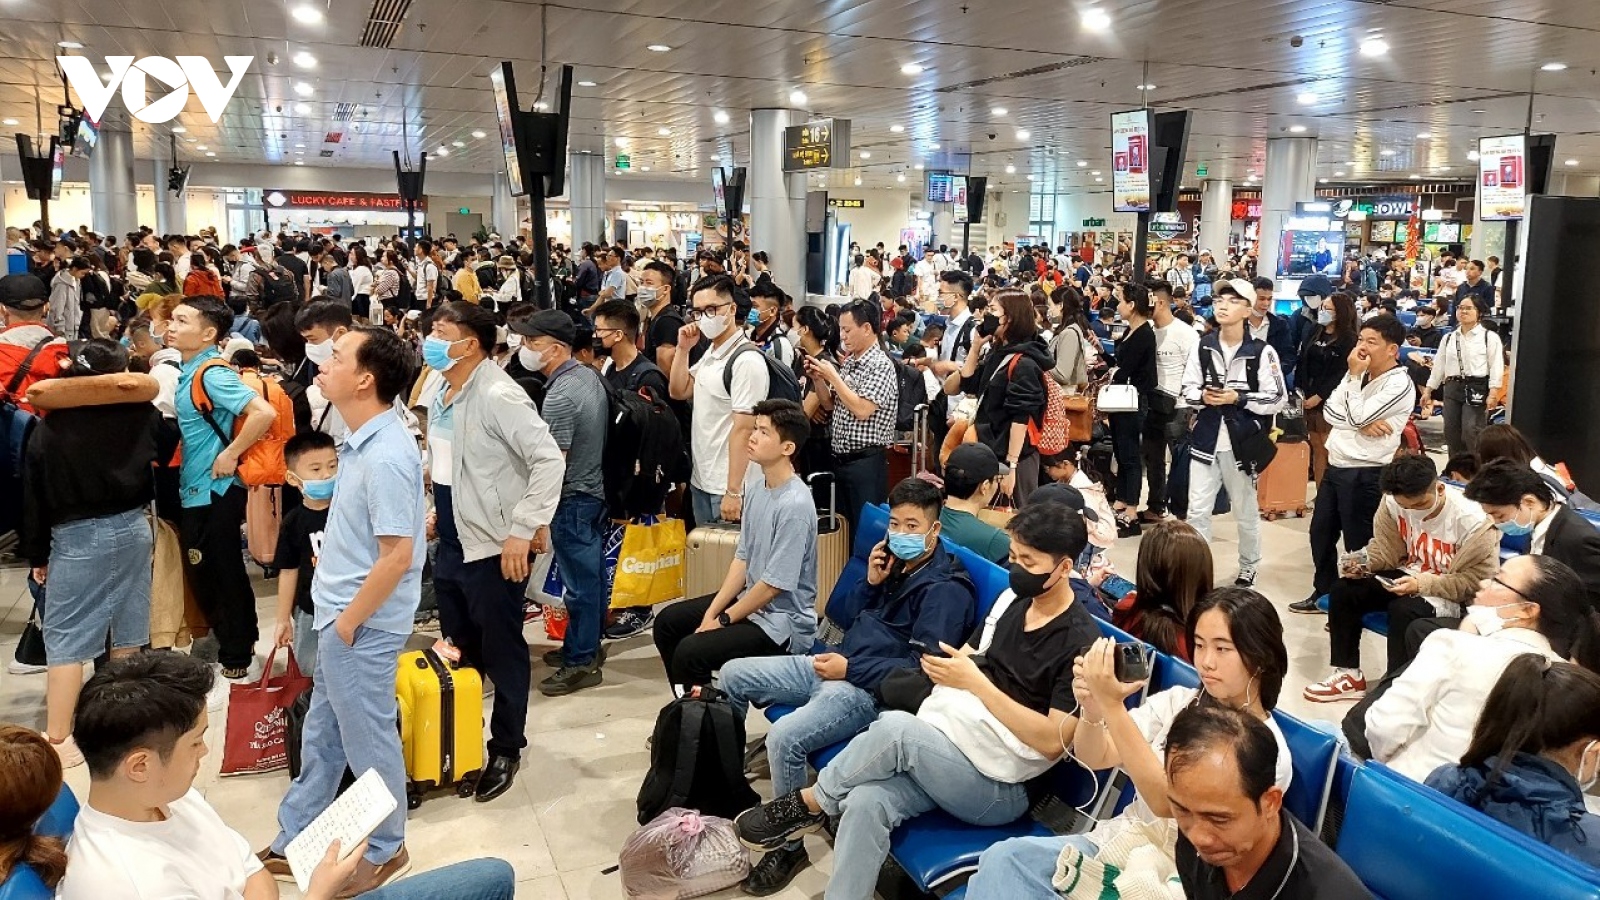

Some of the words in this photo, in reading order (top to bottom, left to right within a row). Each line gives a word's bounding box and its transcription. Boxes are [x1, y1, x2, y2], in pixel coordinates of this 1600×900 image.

[810, 127, 820, 143] 16
[291, 195, 326, 205] LUCKY
[328, 196, 356, 207] CAFE
[359, 198, 368, 207] &
